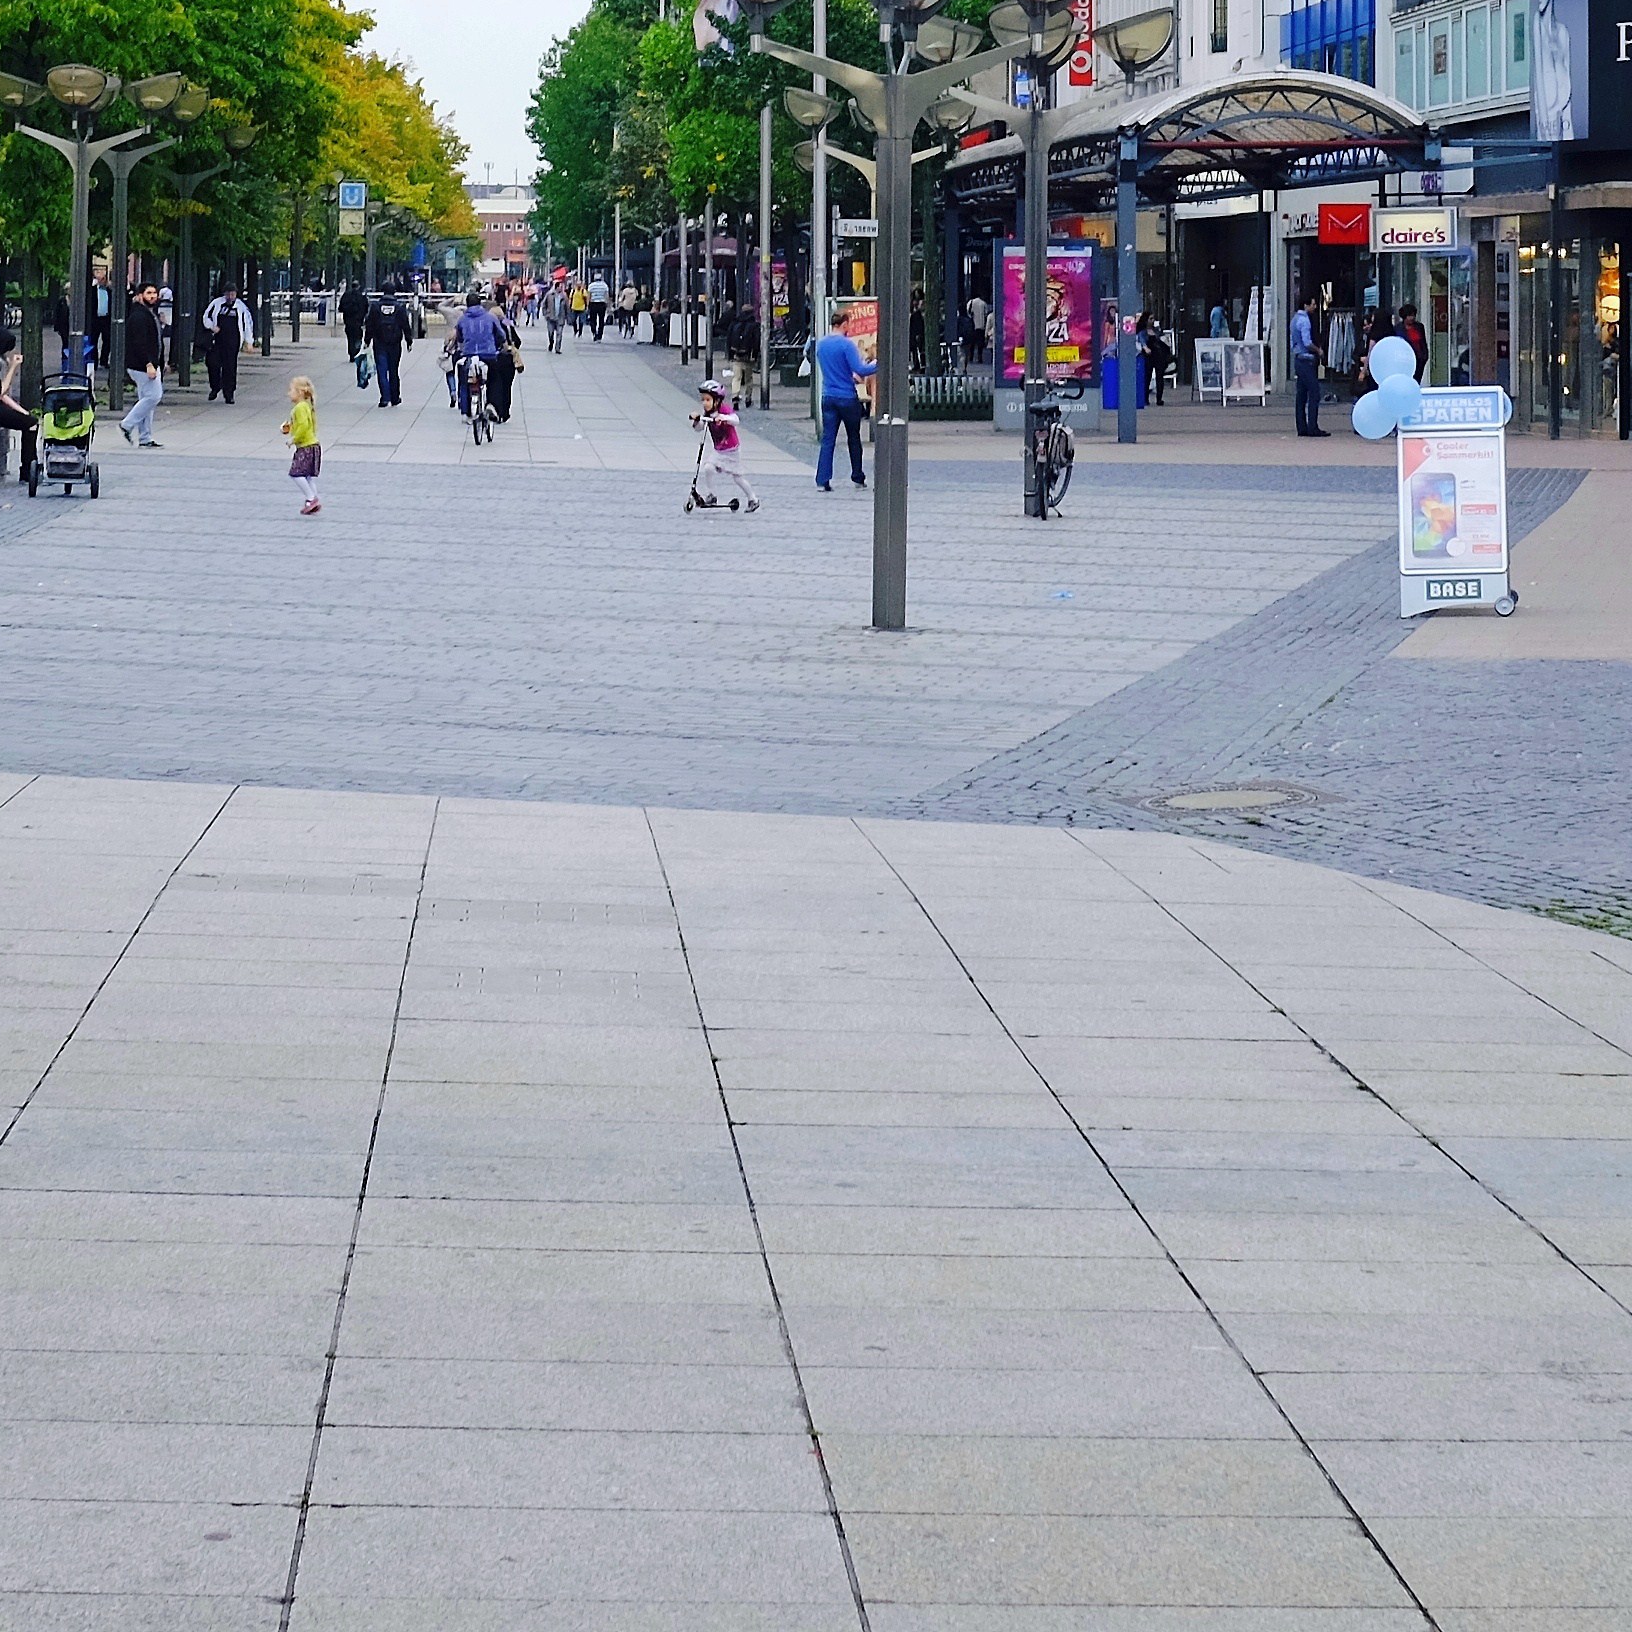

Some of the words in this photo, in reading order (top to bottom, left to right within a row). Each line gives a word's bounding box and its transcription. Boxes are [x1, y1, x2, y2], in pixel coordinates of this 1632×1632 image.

[1380, 226, 1446, 245] claire's
[1409, 406, 1492, 423] SPAREN
[1436, 441, 1470, 451] Cooler
[1429, 581, 1479, 598] BASE
